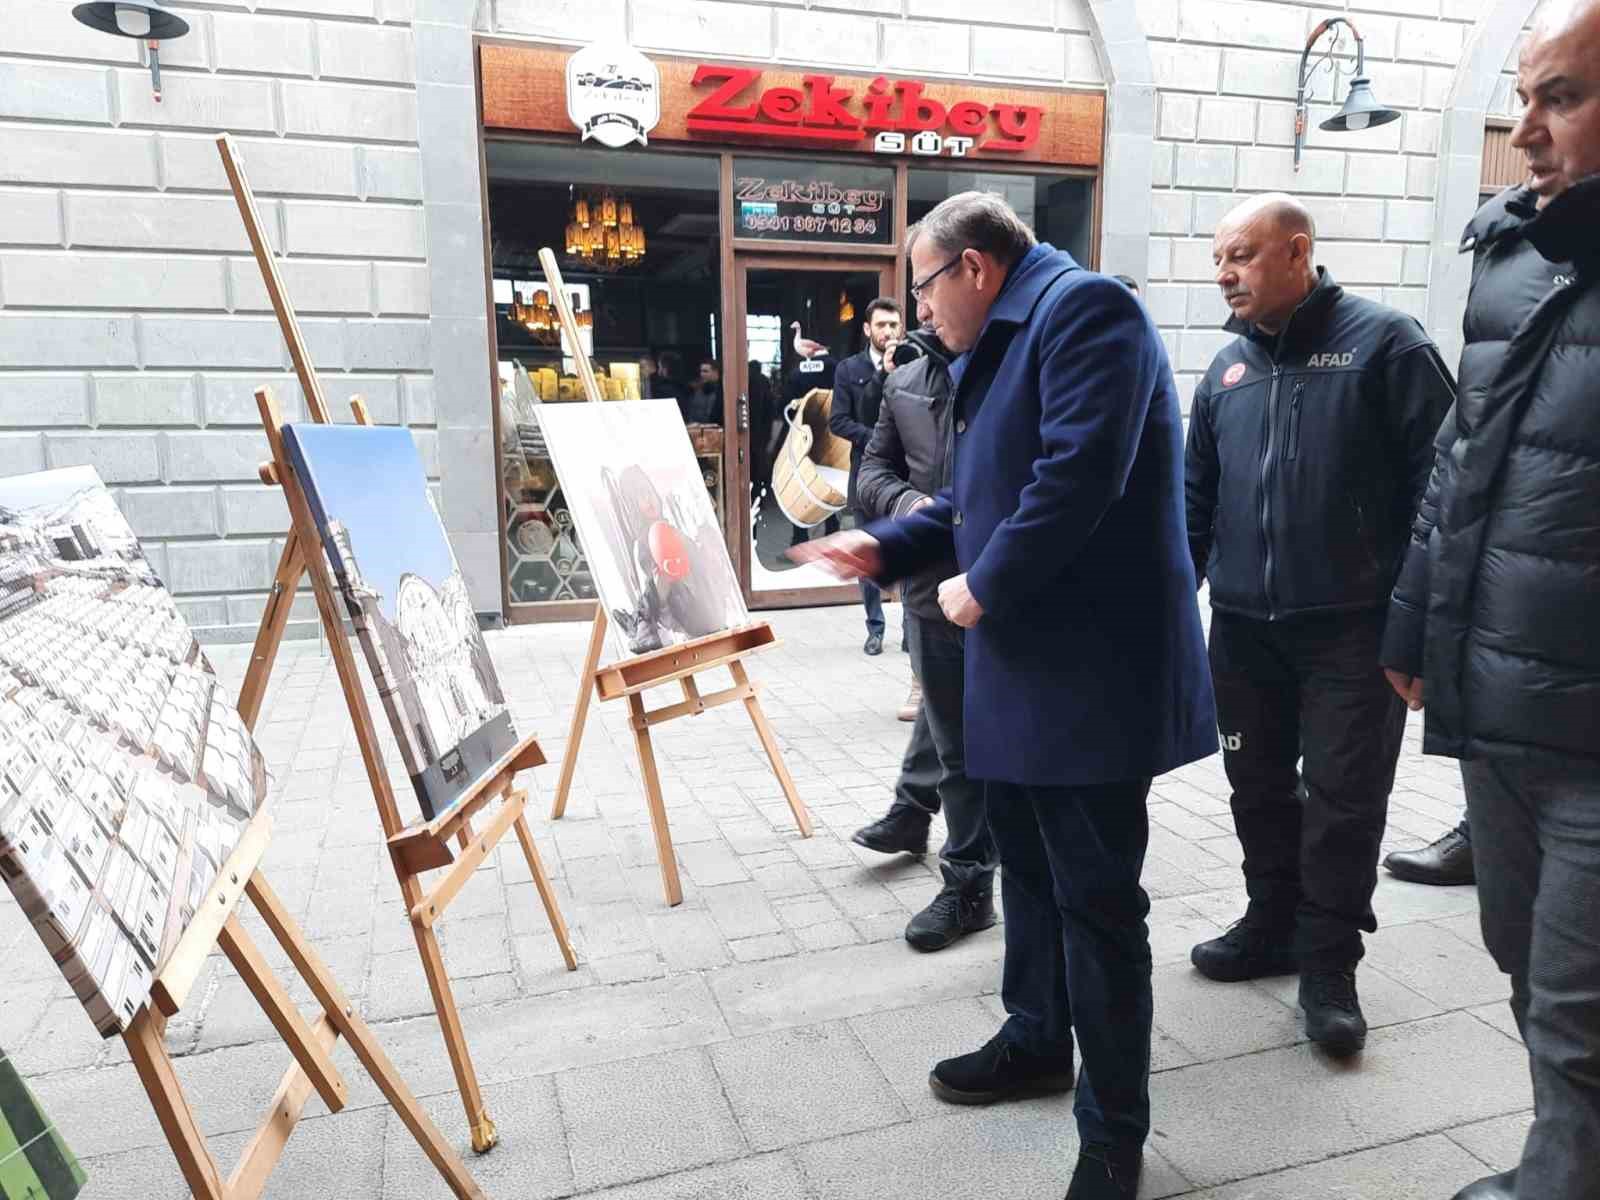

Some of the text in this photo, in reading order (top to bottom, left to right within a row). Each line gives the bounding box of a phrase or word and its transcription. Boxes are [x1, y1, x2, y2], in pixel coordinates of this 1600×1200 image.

[686, 64, 1045, 151] Zekibey
[874, 131, 974, 157] SÜT
[736, 177, 885, 212] Zekibey
[1307, 351, 1354, 367] AFAD
